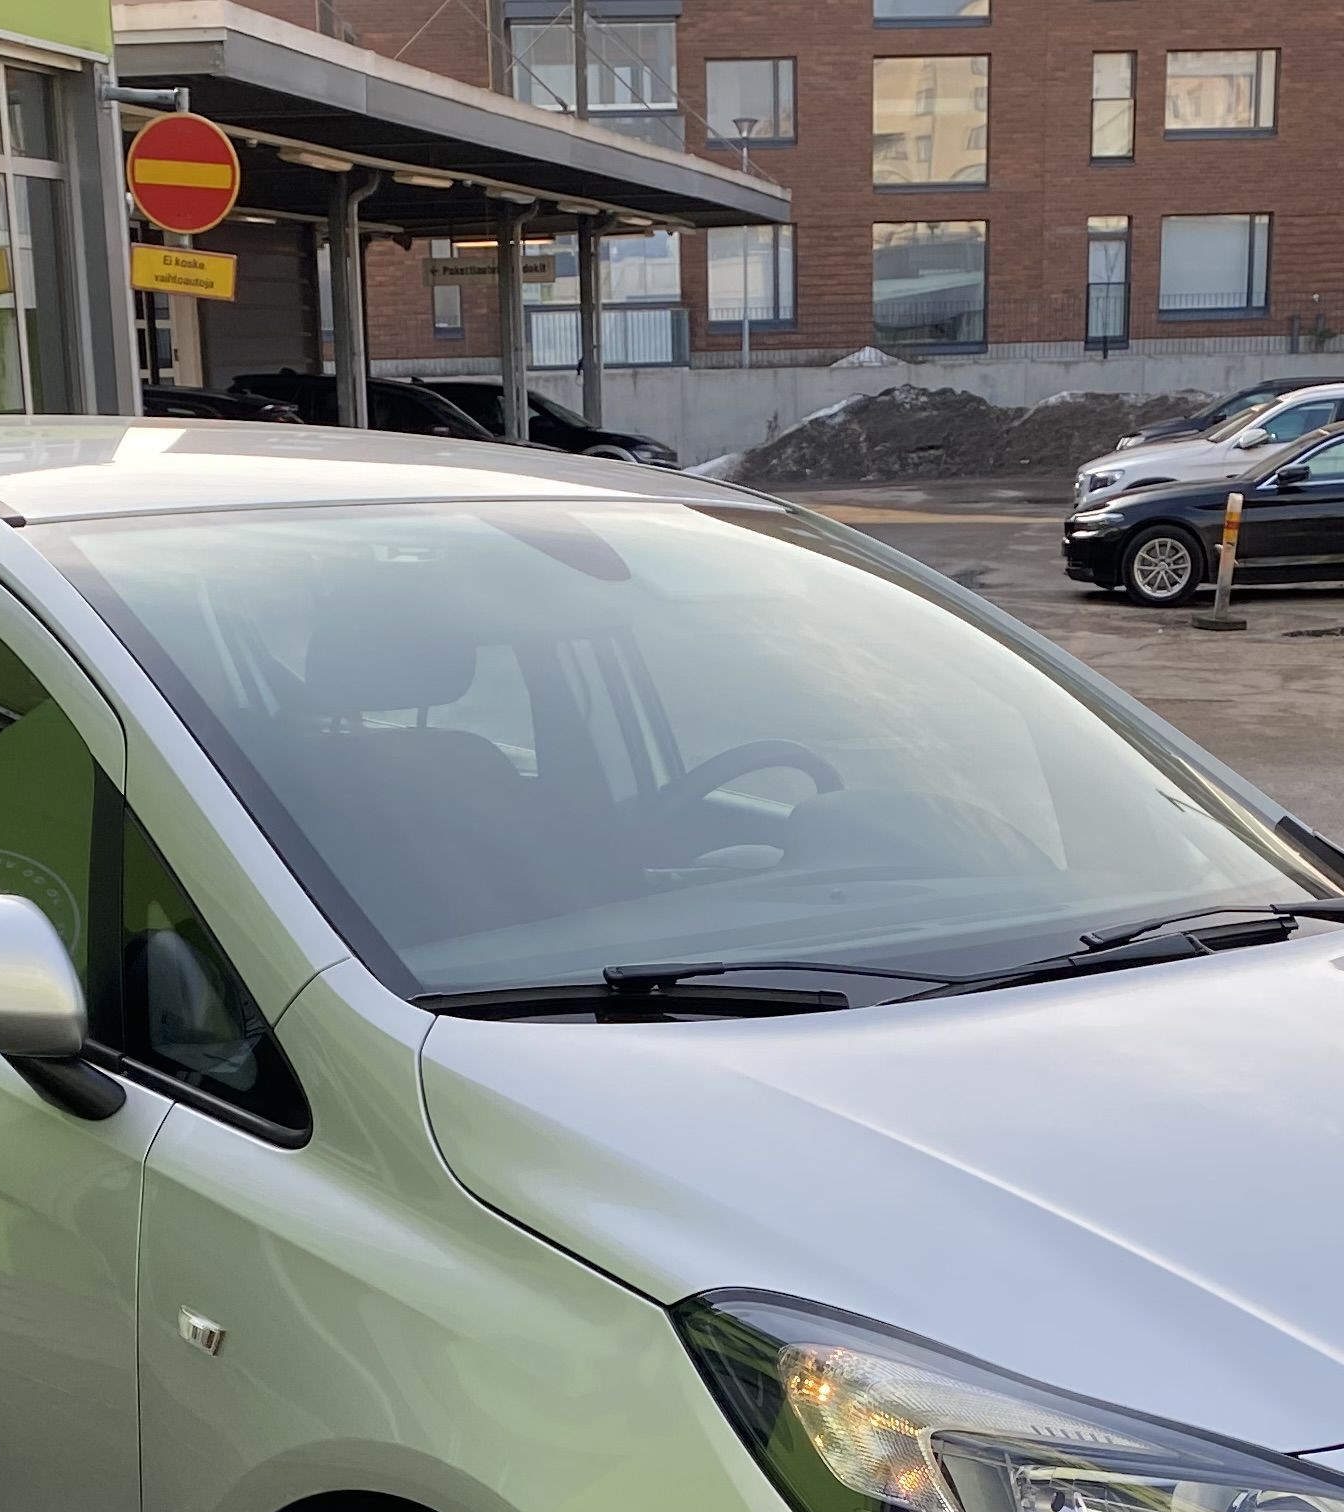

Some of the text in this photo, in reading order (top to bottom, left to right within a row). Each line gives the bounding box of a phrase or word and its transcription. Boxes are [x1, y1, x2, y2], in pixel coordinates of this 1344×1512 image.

[163, 255, 205, 270] Ei koske
[154, 272, 214, 289] vaihtoautoja
